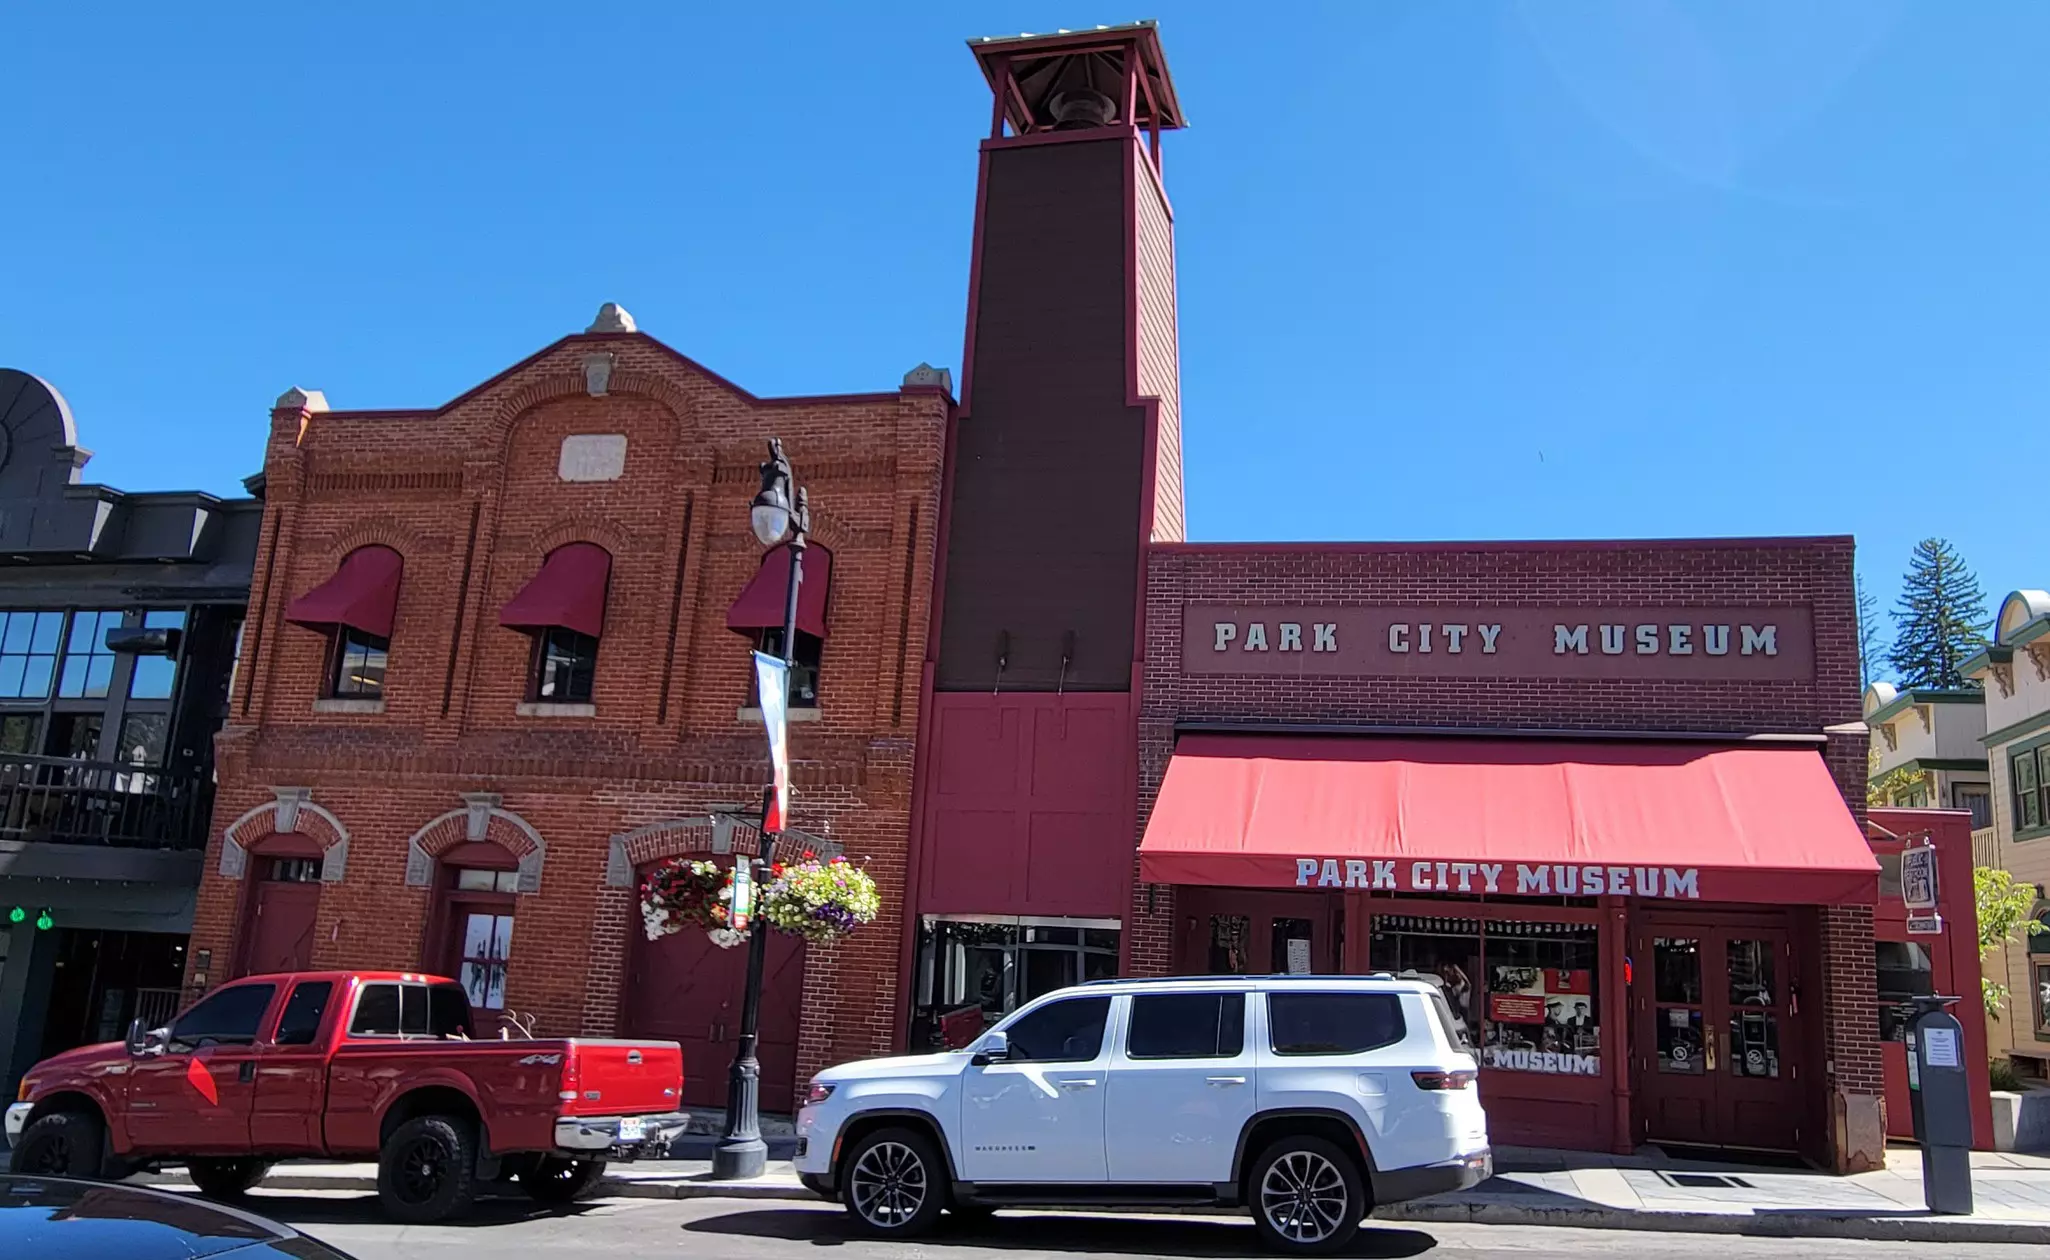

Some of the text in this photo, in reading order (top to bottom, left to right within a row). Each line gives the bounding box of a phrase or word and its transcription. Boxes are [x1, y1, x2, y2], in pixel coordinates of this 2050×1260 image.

[1214, 623, 1777, 655] PARK CITY MUSEUM
[1296, 858, 1699, 898] PARK CITY MUSEUM
[1493, 1049, 1595, 1074] MUSEUM
